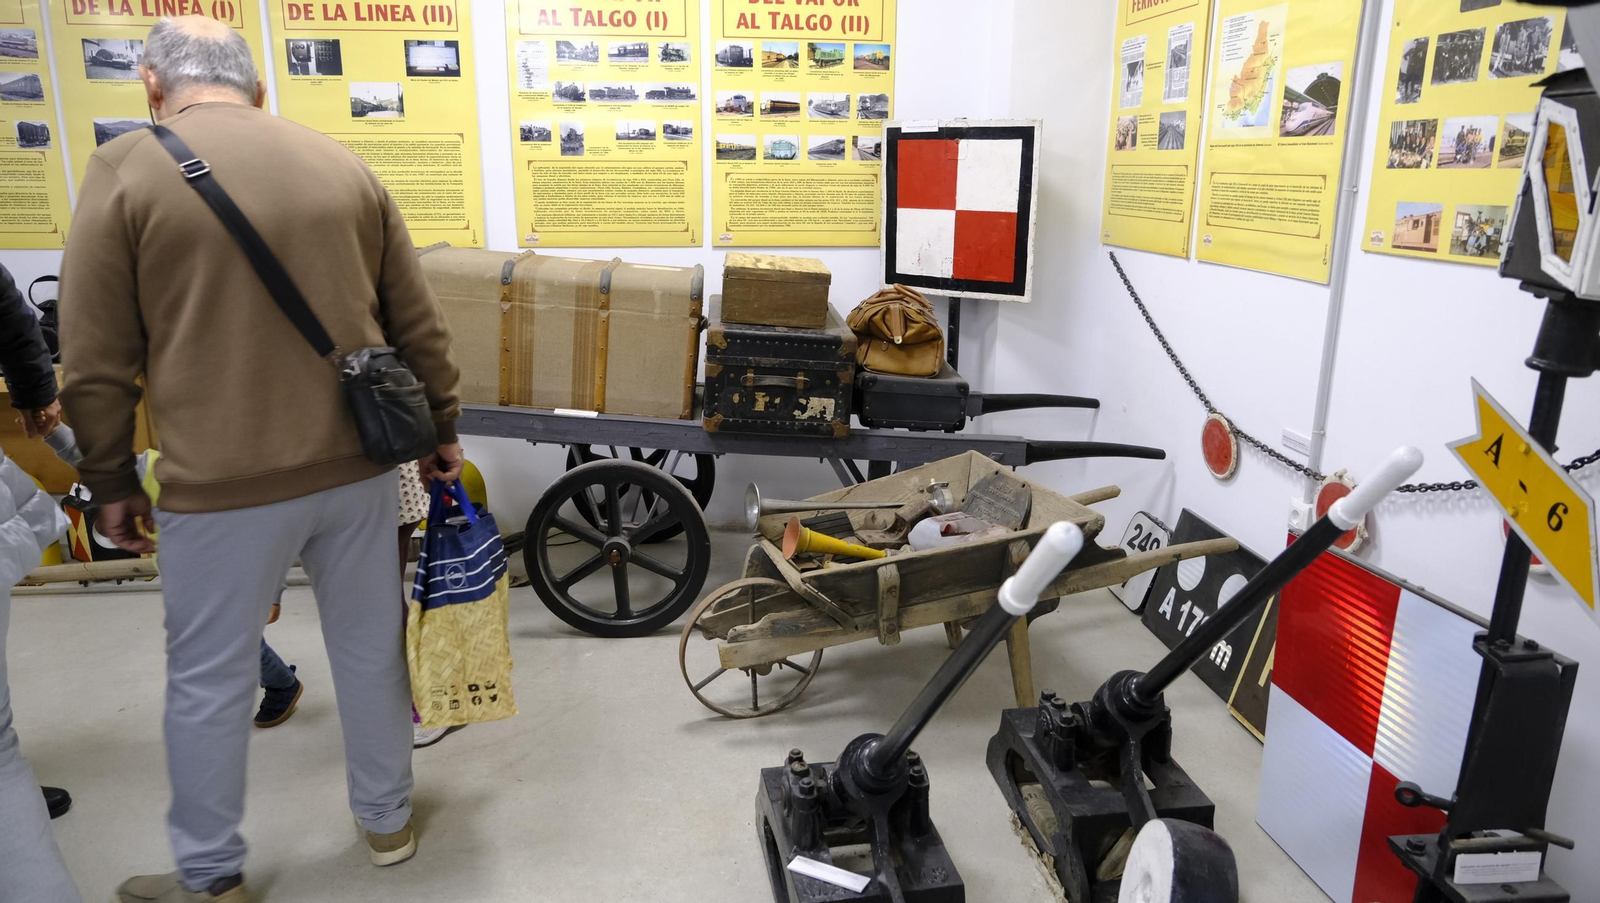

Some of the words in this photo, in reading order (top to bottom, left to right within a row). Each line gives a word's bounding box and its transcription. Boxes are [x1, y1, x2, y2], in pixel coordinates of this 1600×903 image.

[72, 0, 101, 16] DE
[108, 0, 135, 17] LA
[211, 0, 235, 22] (I)
[287, 3, 315, 21] DE
[321, 3, 348, 21] LA
[353, 2, 416, 22] LINEA
[422, 5, 453, 26] (II)
[537, 9, 562, 27] AL
[569, 7, 637, 27] TALGO
[645, 11, 668, 31] (I)
[736, 12, 761, 30] AL
[767, 11, 832, 31] TALGO
[840, 15, 870, 35] (II)
[1158, 586, 1177, 621] A
[1177, 599, 1210, 637] 17
